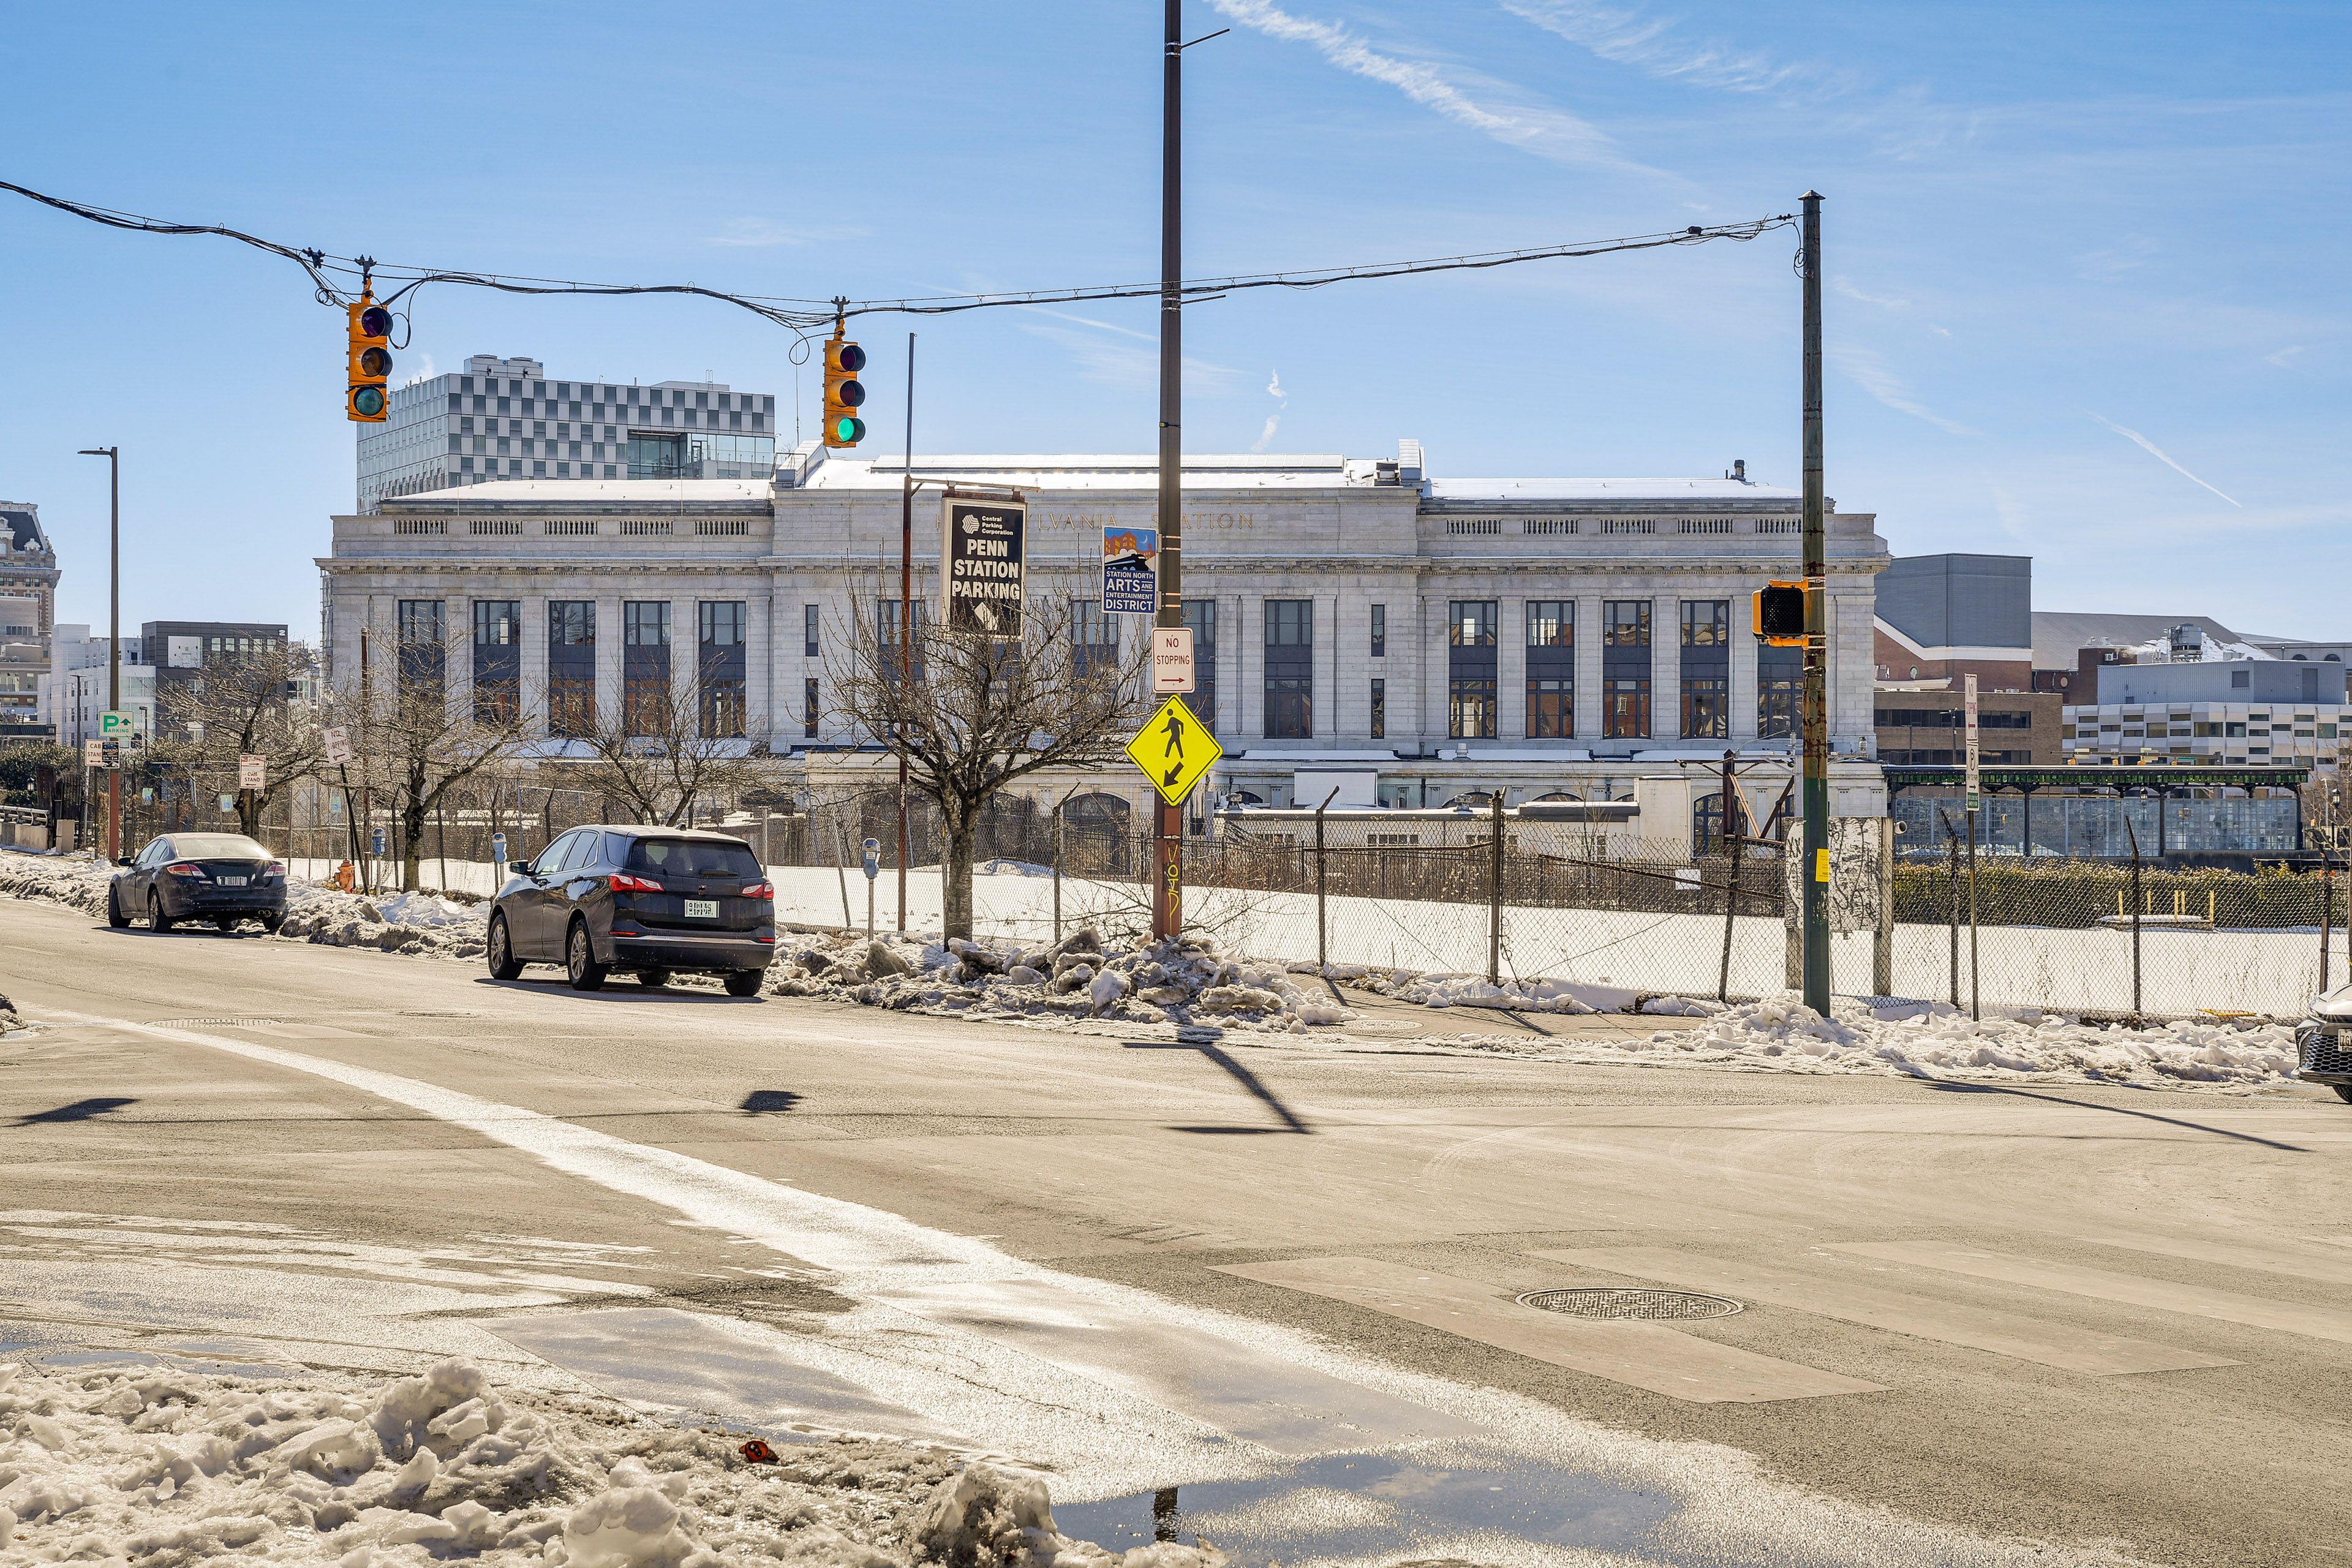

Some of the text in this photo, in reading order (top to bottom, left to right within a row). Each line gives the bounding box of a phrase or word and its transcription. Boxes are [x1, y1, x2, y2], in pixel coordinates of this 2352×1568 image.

[1150, 513, 1253, 529] SATION
[967, 539, 1008, 557] PENN
[954, 559, 1019, 578] STATION
[952, 580, 1020, 600] PARKING
[1106, 578, 1140, 592] ARTS
[1106, 599, 1153, 611] DISTRICT
[1166, 638, 1179, 647] NO
[1156, 655, 1189, 665] STOPPING
